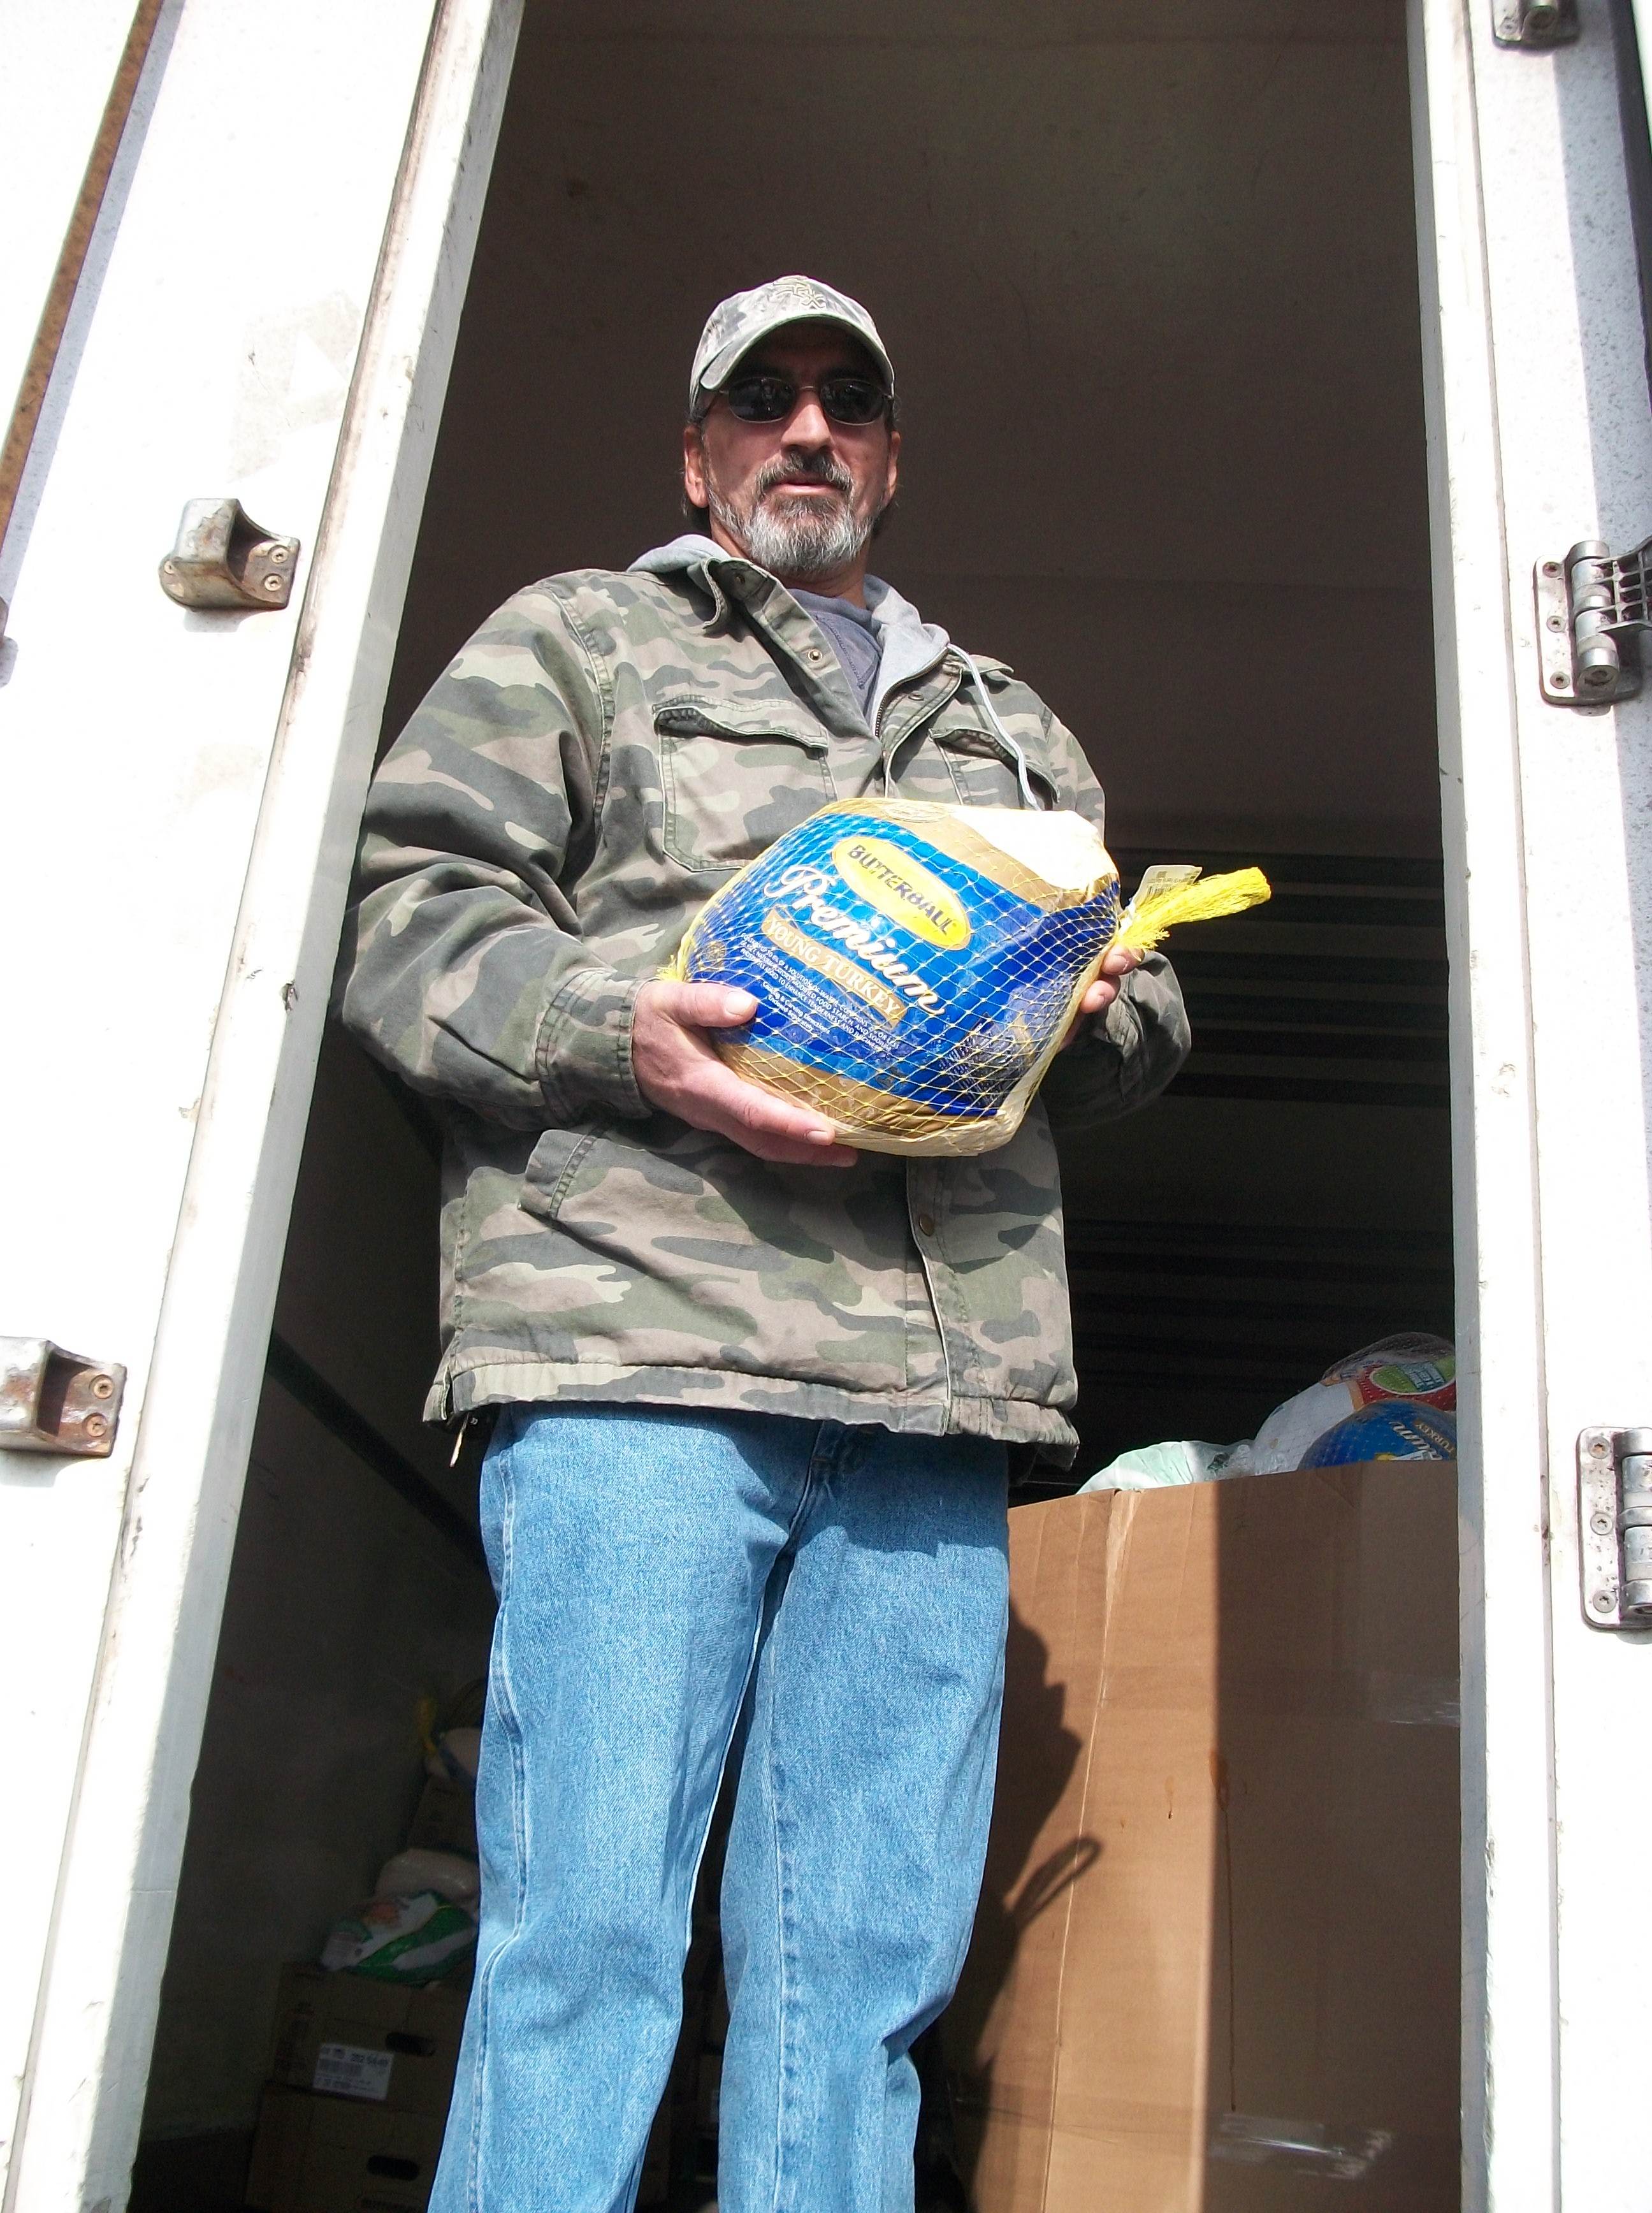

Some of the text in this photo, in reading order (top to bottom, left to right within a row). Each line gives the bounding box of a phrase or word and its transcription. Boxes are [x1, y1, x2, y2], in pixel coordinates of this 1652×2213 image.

[847, 845, 951, 936] BUTTERBALL
[764, 866, 945, 1015] Premium
[767, 917, 901, 1015] YOUNG TURKEY
[783, 998, 804, 1017] Carving
[815, 996, 832, 1011] FOOD
[855, 1023, 869, 1035] AND
[841, 1022, 854, 1034] AND
[1416, 1422, 1453, 1453] TURKEY
